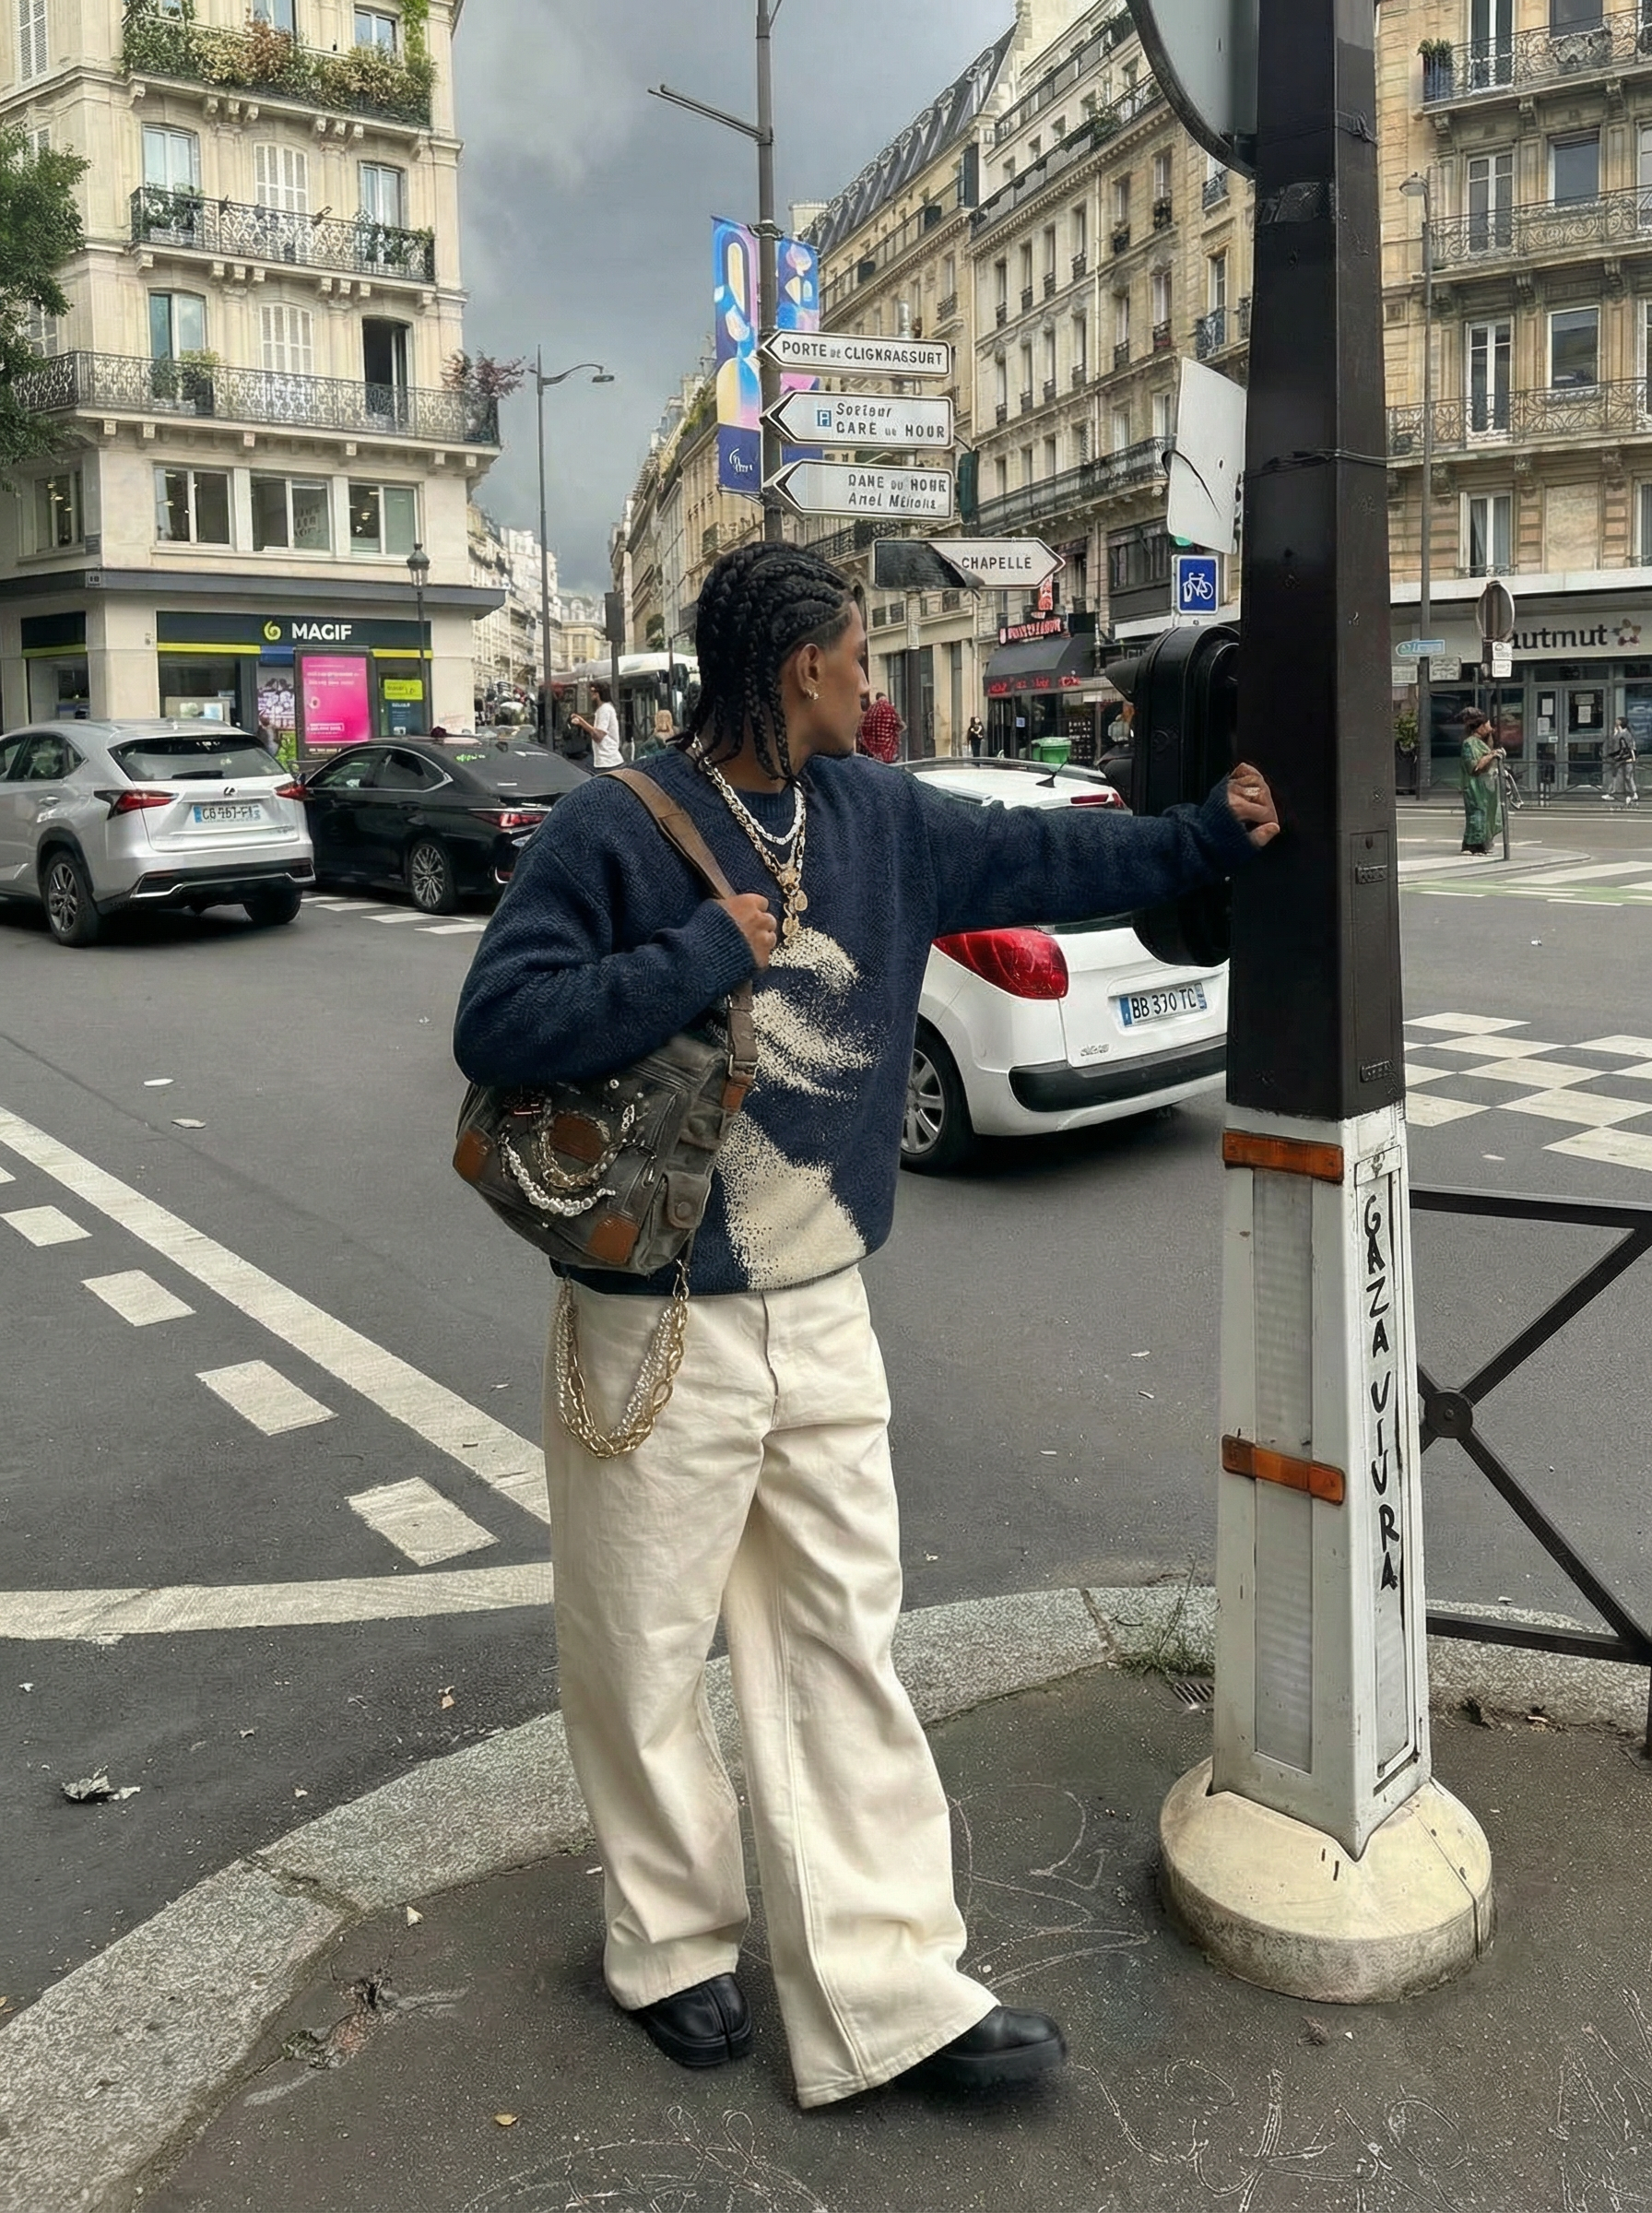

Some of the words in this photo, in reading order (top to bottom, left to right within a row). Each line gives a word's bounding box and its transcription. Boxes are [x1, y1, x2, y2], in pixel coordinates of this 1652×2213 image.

[782, 340, 827, 358] PORTE
[905, 424, 945, 438] HOUR
[962, 556, 1032, 570] CHAPELLE
[291, 622, 352, 641] MAGIF
[1130, 997, 1150, 1019] BB
[1179, 988, 1197, 1010] TC
[1363, 1194, 1390, 1358] GAZA
